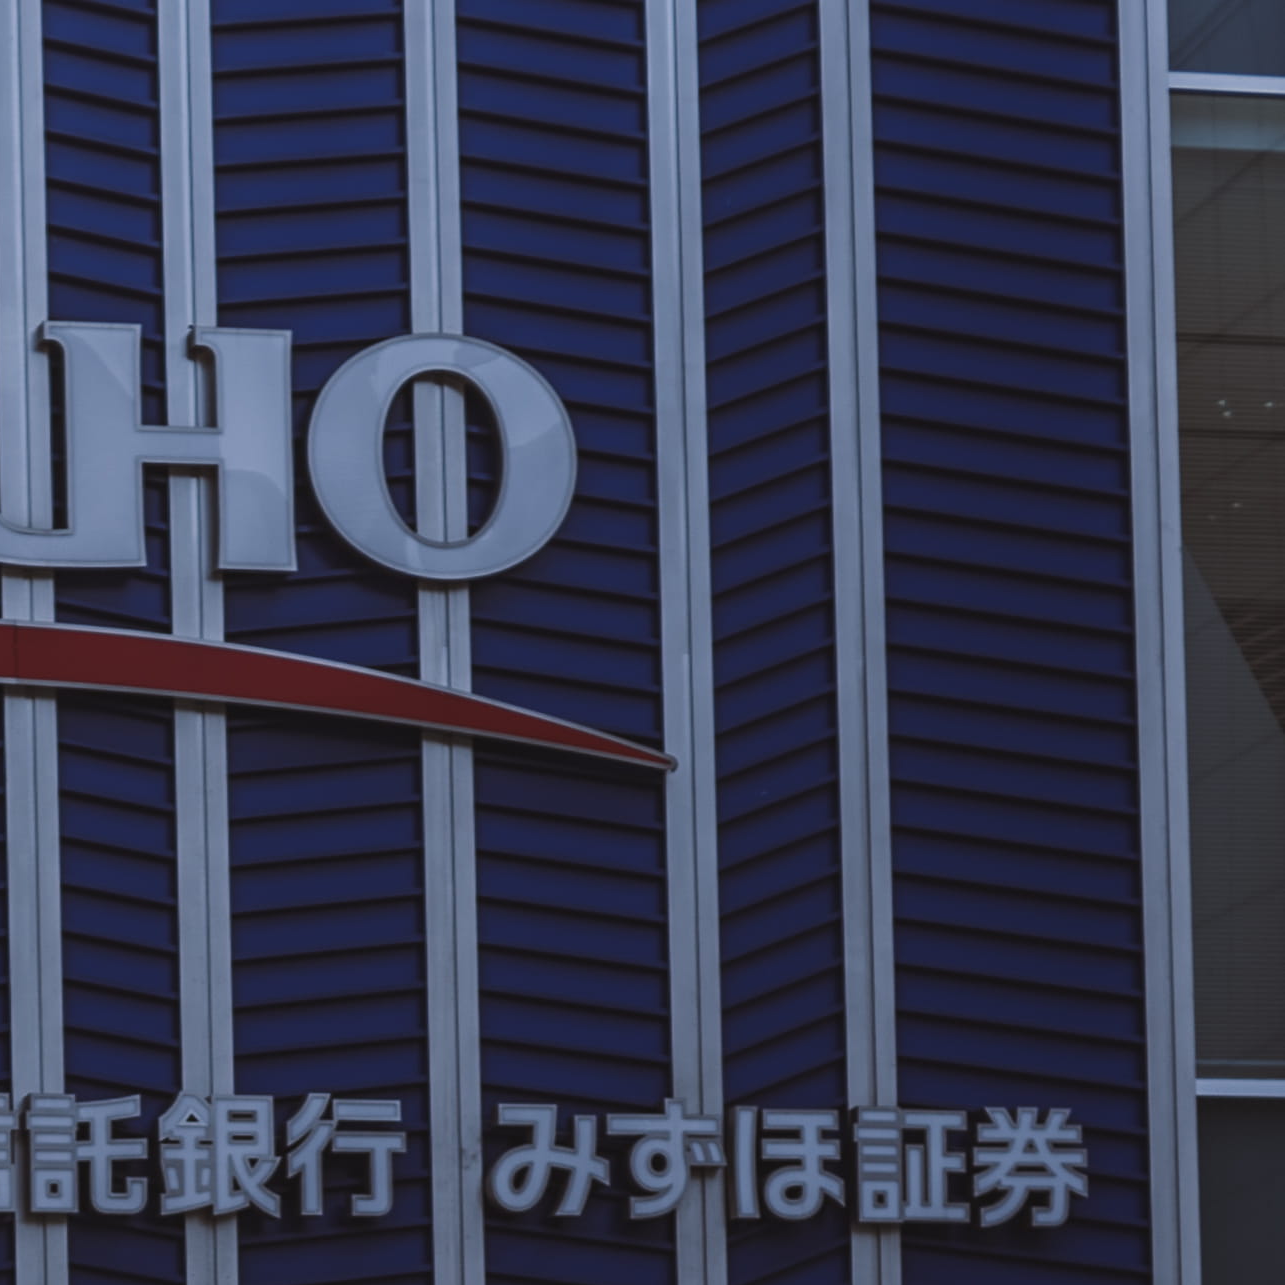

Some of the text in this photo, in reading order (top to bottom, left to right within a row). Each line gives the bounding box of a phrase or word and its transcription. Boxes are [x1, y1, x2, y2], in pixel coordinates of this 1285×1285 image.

[491, 1099, 1088, 1226] みずほ証券
